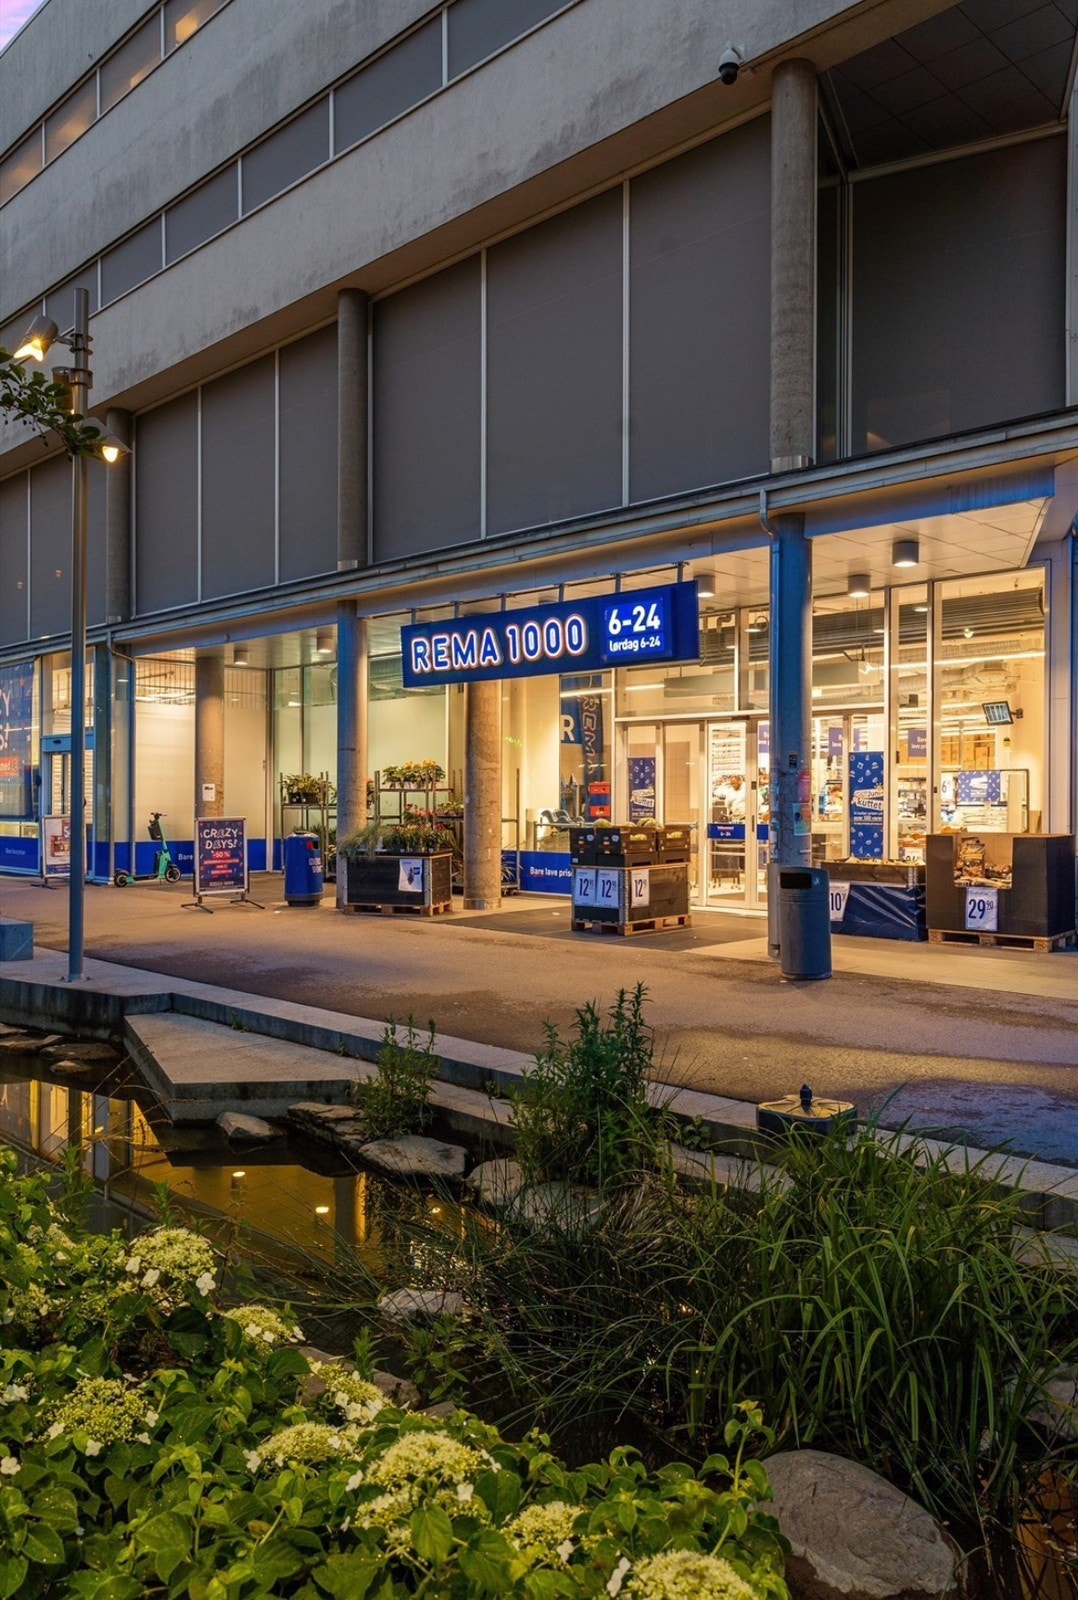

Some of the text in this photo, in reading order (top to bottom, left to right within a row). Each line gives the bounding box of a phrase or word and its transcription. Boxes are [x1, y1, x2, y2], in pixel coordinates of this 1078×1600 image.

[608, 603, 661, 635] 6-24
[411, 614, 588, 674] REMA 1000
[609, 636, 661, 653] lørdag 6-24
[203, 828, 238, 838] CRAZY
[205, 839, 238, 849] DAYS!
[529, 866, 544, 875] Bare
[545, 867, 558, 876] lave
